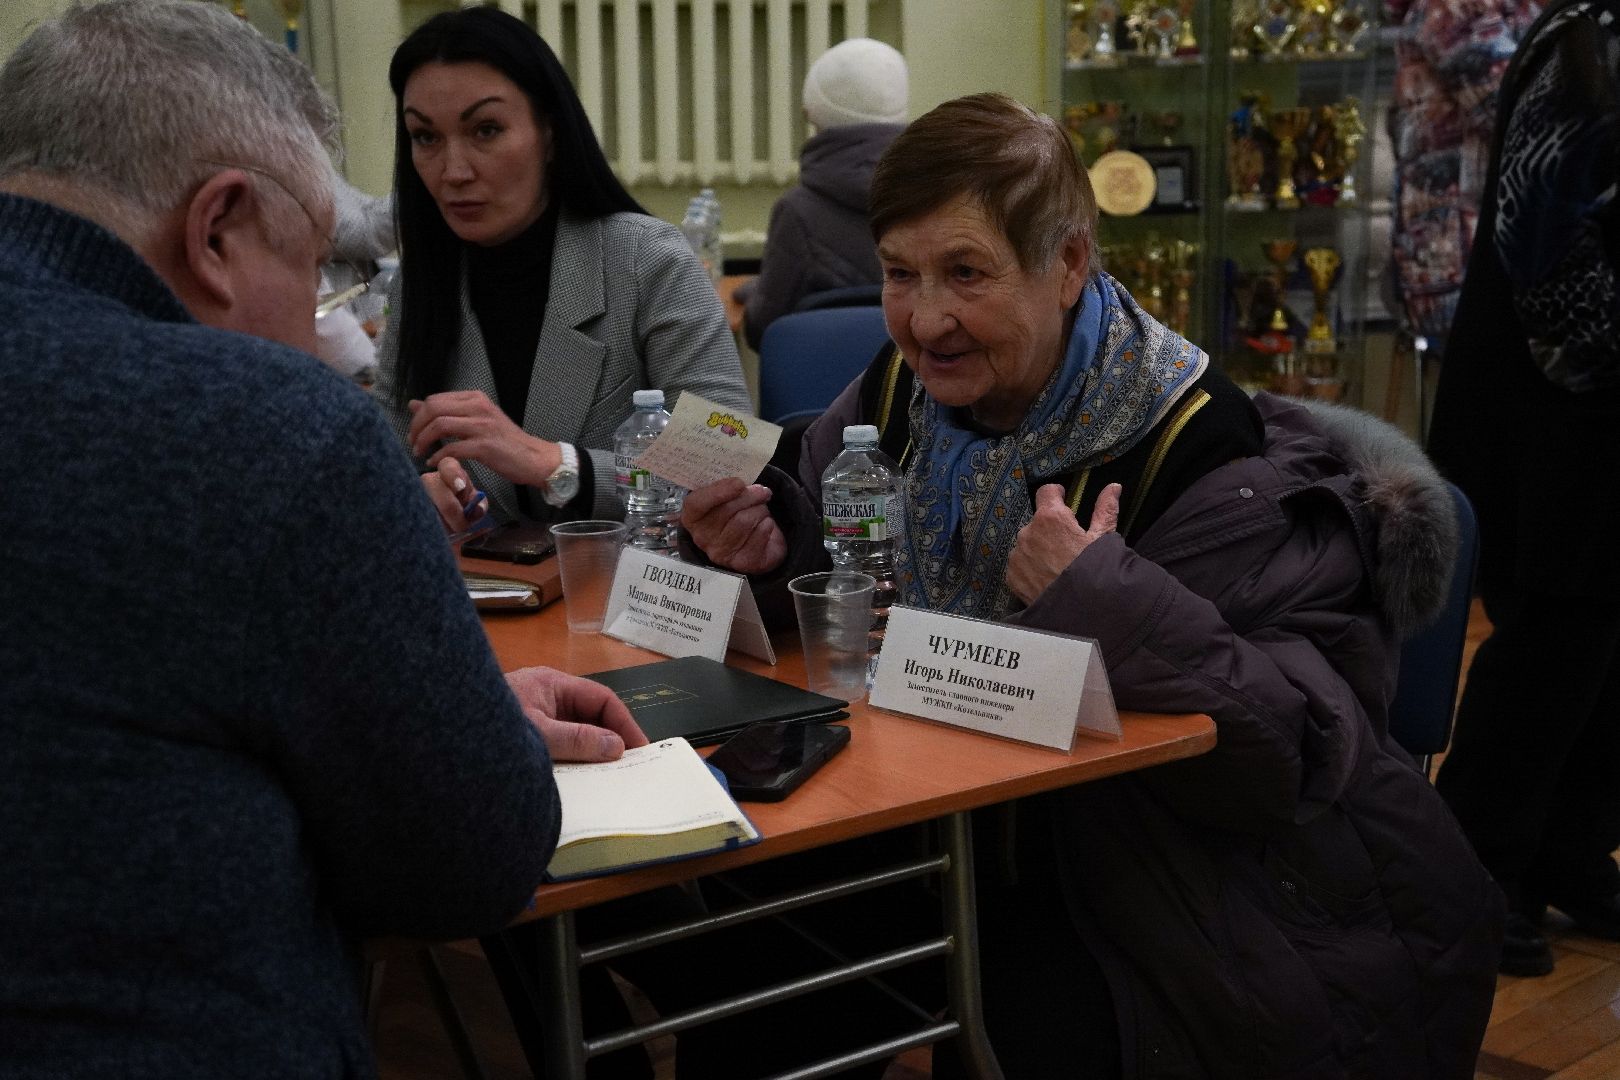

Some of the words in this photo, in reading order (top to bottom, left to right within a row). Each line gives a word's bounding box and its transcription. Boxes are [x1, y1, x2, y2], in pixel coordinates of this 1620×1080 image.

[823, 503, 876, 518] ЕНЕЖСКАЯ
[642, 564, 702, 595] ГВОЗДЕВА
[626, 584, 658, 606] Марина
[659, 594, 712, 622] Викторовна
[928, 634, 1021, 670] ЧУРМЕЕВ
[904, 658, 944, 683] Игорь
[947, 667, 1036, 701] Николаевич
[907, 680, 947, 697] Заместитель
